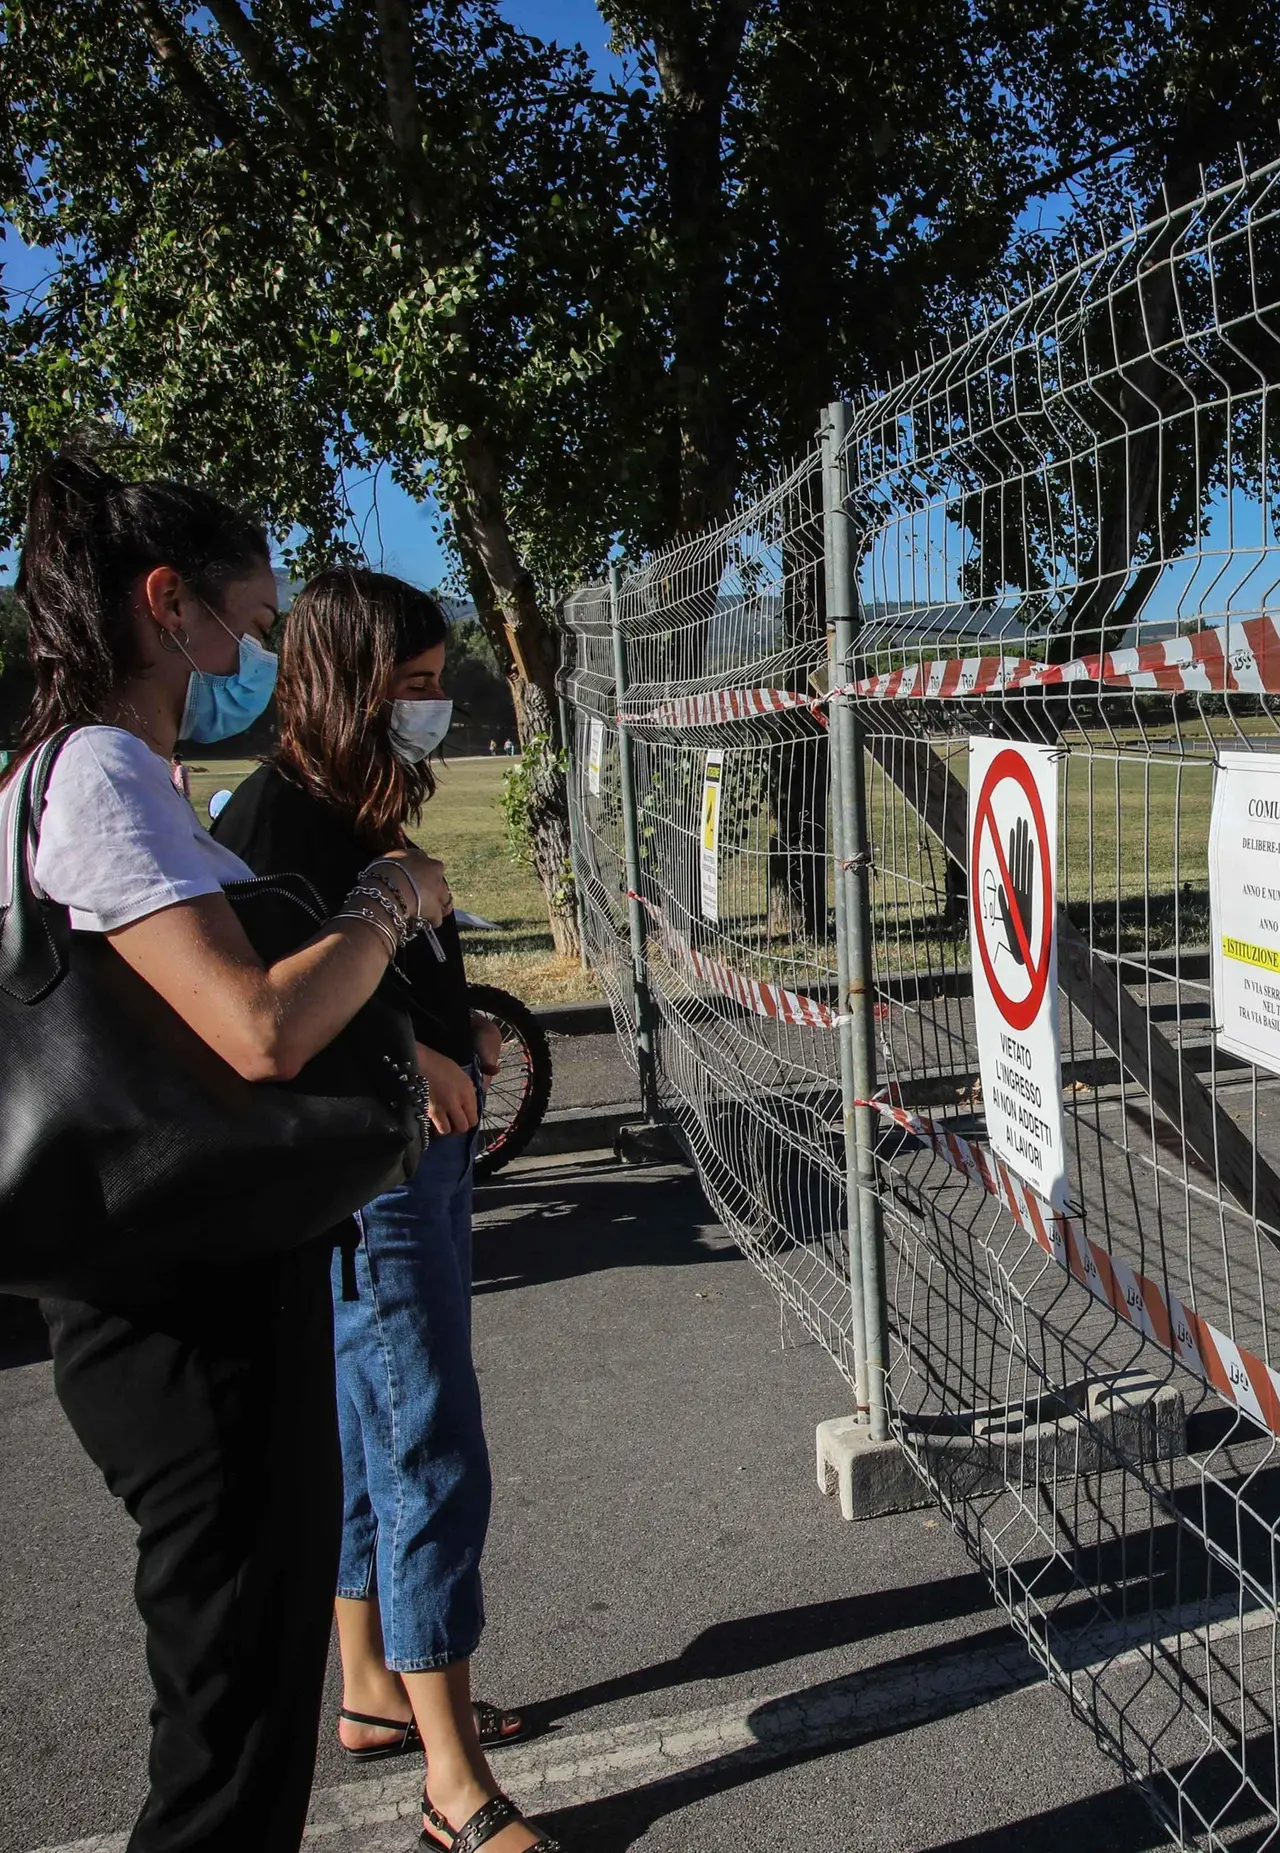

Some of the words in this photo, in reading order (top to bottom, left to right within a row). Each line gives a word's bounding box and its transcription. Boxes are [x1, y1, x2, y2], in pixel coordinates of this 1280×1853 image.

[1243, 884, 1261, 898] ANNO
[1262, 887, 1267, 899] E
[1259, 918, 1278, 933] ANNO
[1227, 940, 1279, 967] ISTITUZIONE
[1244, 978, 1251, 990] IN
[1251, 980, 1263, 994] VIA
[1239, 1006, 1251, 1020] TRA
[1251, 1010, 1262, 1025] VIA
[1262, 1000, 1275, 1015] NEL
[1000, 1032, 1032, 1071] VIETATO
[996, 1059, 1041, 1109] L'INGRESSO
[992, 1086, 1000, 1108] AI
[1000, 1093, 1017, 1120] NON
[1019, 1105, 1053, 1148] ADDETTI
[1006, 1125, 1014, 1149] AI
[1015, 1131, 1043, 1172] LAVORI
